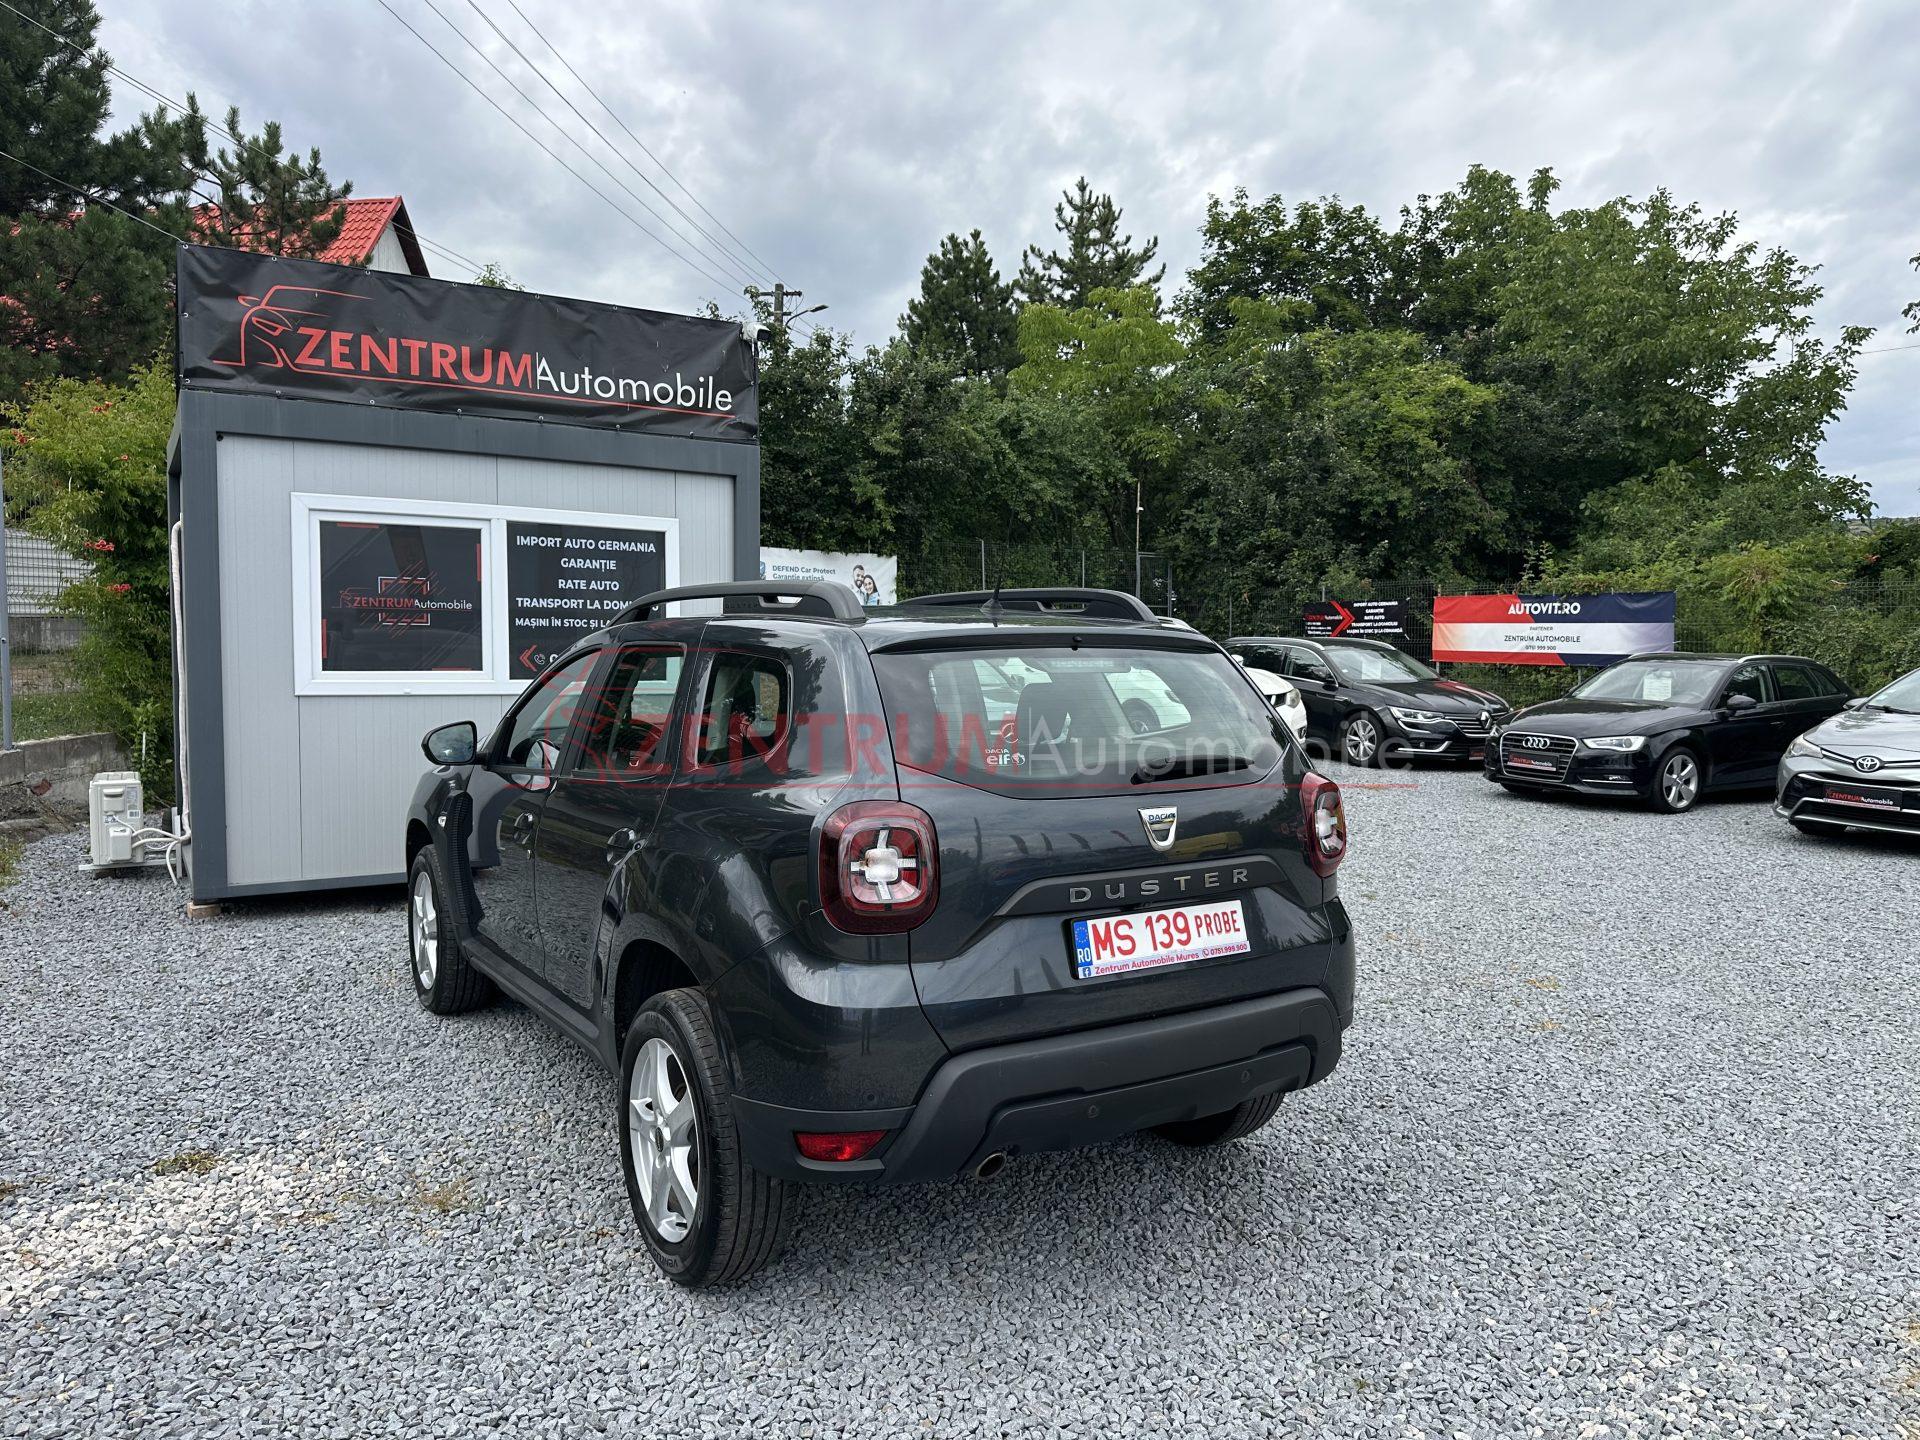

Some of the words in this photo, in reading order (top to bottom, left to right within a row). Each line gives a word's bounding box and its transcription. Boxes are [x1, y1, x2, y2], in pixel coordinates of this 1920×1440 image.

[295, 327, 532, 388] ZENTRUM
[537, 356, 732, 411] Automobile
[517, 536, 562, 548] IMPORT
[564, 539, 596, 550] AUTO
[598, 540, 656, 553] GERMANIA
[772, 565, 800, 573] DEFEND
[559, 579, 587, 590] RATE
[589, 581, 620, 591] AUTO
[353, 597, 414, 608] ZENTRUM
[414, 600, 473, 610] Automobile
[516, 597, 585, 609] TRANSPORT
[587, 600, 601, 610] LA
[1508, 602, 1581, 615] AUTOVIT.RO
[551, 617, 562, 627] ÎN
[564, 619, 587, 628] STOC
[986, 755, 1011, 765] elf
[1861, 797, 1894, 806] Automobile
[1148, 813, 1176, 821] DACIA
[1070, 869, 1248, 903] DUSTER
[1092, 920, 1137, 961] MS
[1145, 911, 1192, 951] 139
[1195, 910, 1241, 938] PROBE
[1078, 947, 1091, 962] RO
[1095, 964, 1130, 975] Zentrum
[1132, 956, 1175, 970] Automobile
[1177, 951, 1200, 961] Mures
